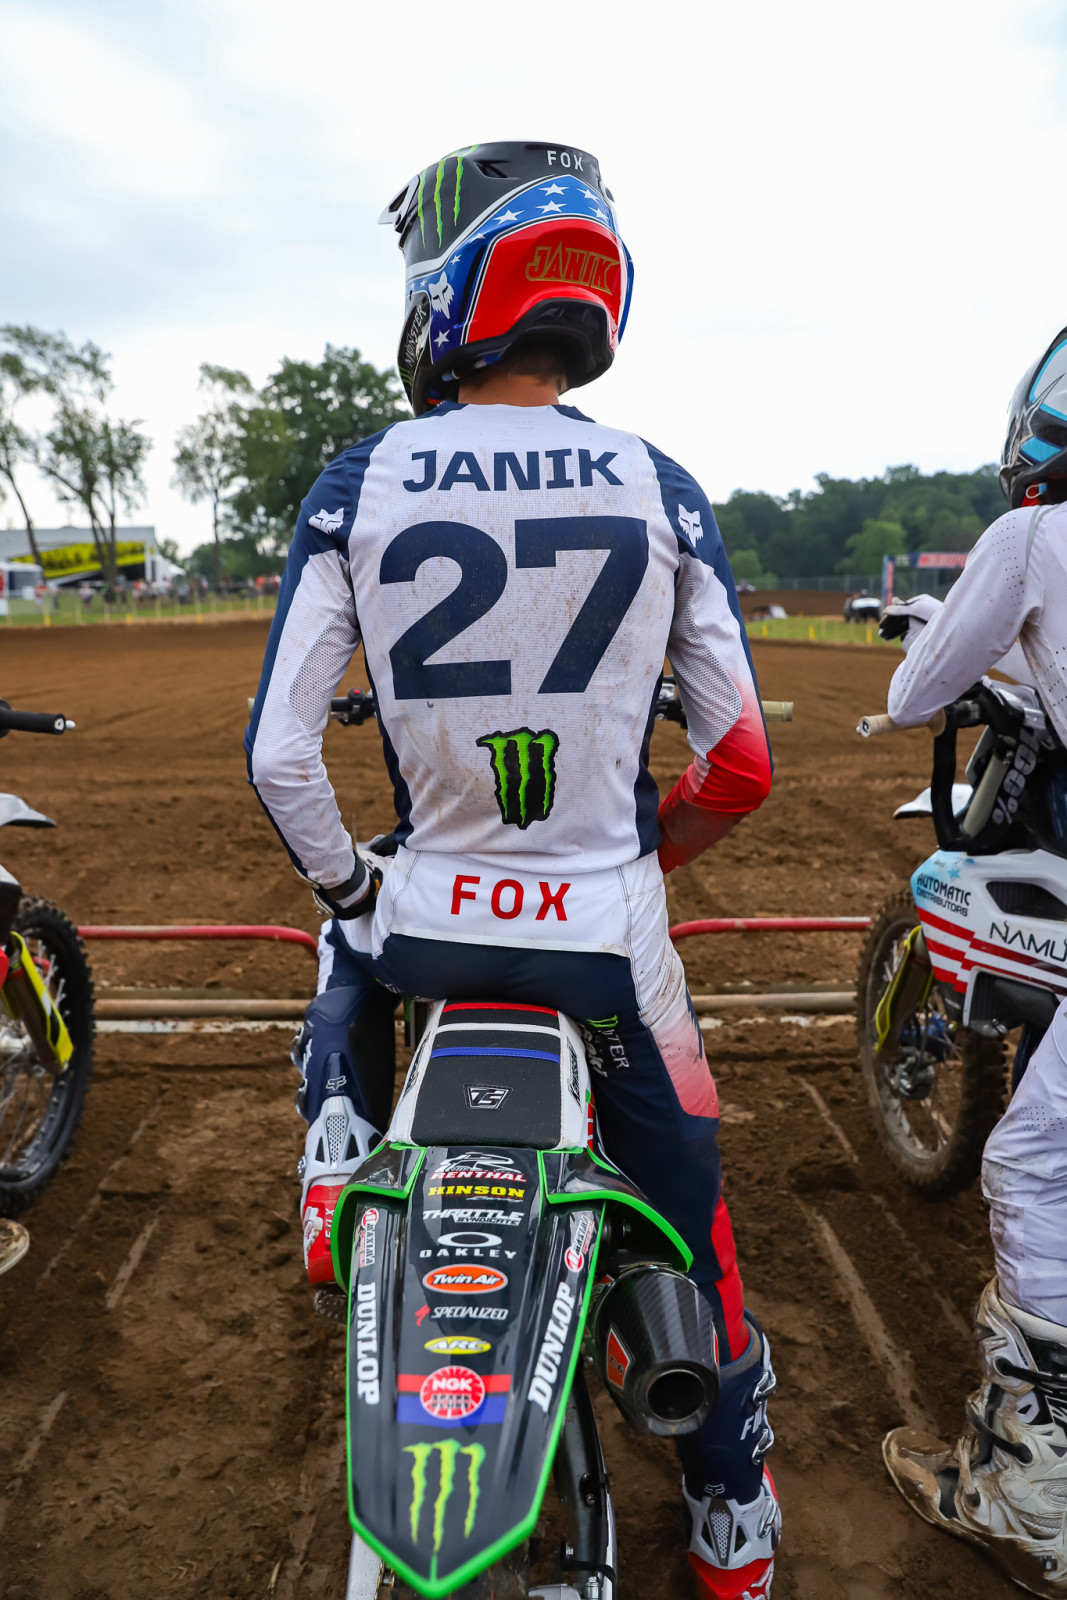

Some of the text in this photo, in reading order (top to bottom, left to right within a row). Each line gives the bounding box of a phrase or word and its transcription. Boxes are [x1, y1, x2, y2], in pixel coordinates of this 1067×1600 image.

[546, 150, 584, 171] FOX
[525, 241, 620, 296] JANIK
[404, 304, 427, 368] MONSTER
[402, 448, 624, 492] JANIK
[379, 515, 649, 700] 27
[450, 874, 571, 921] FOX
[916, 873, 972, 906] AUTOMATIC
[916, 887, 969, 917] DISTRIBUTORS
[430, 1171, 527, 1182] RENTHAL
[427, 1185, 525, 1198] HINSON
[422, 1208, 525, 1221] THROTTLE
[455, 1216, 520, 1226] SYNDICATE
[419, 1248, 517, 1259] OAKLEY
[432, 1273, 502, 1285] Twin Air
[430, 1305, 509, 1321] SPECIALIZED
[357, 1281, 380, 1405] DUNLOP
[427, 1340, 488, 1351] ARC
[527, 1281, 576, 1413] DUNLOP
[432, 1377, 473, 1391] NGK
